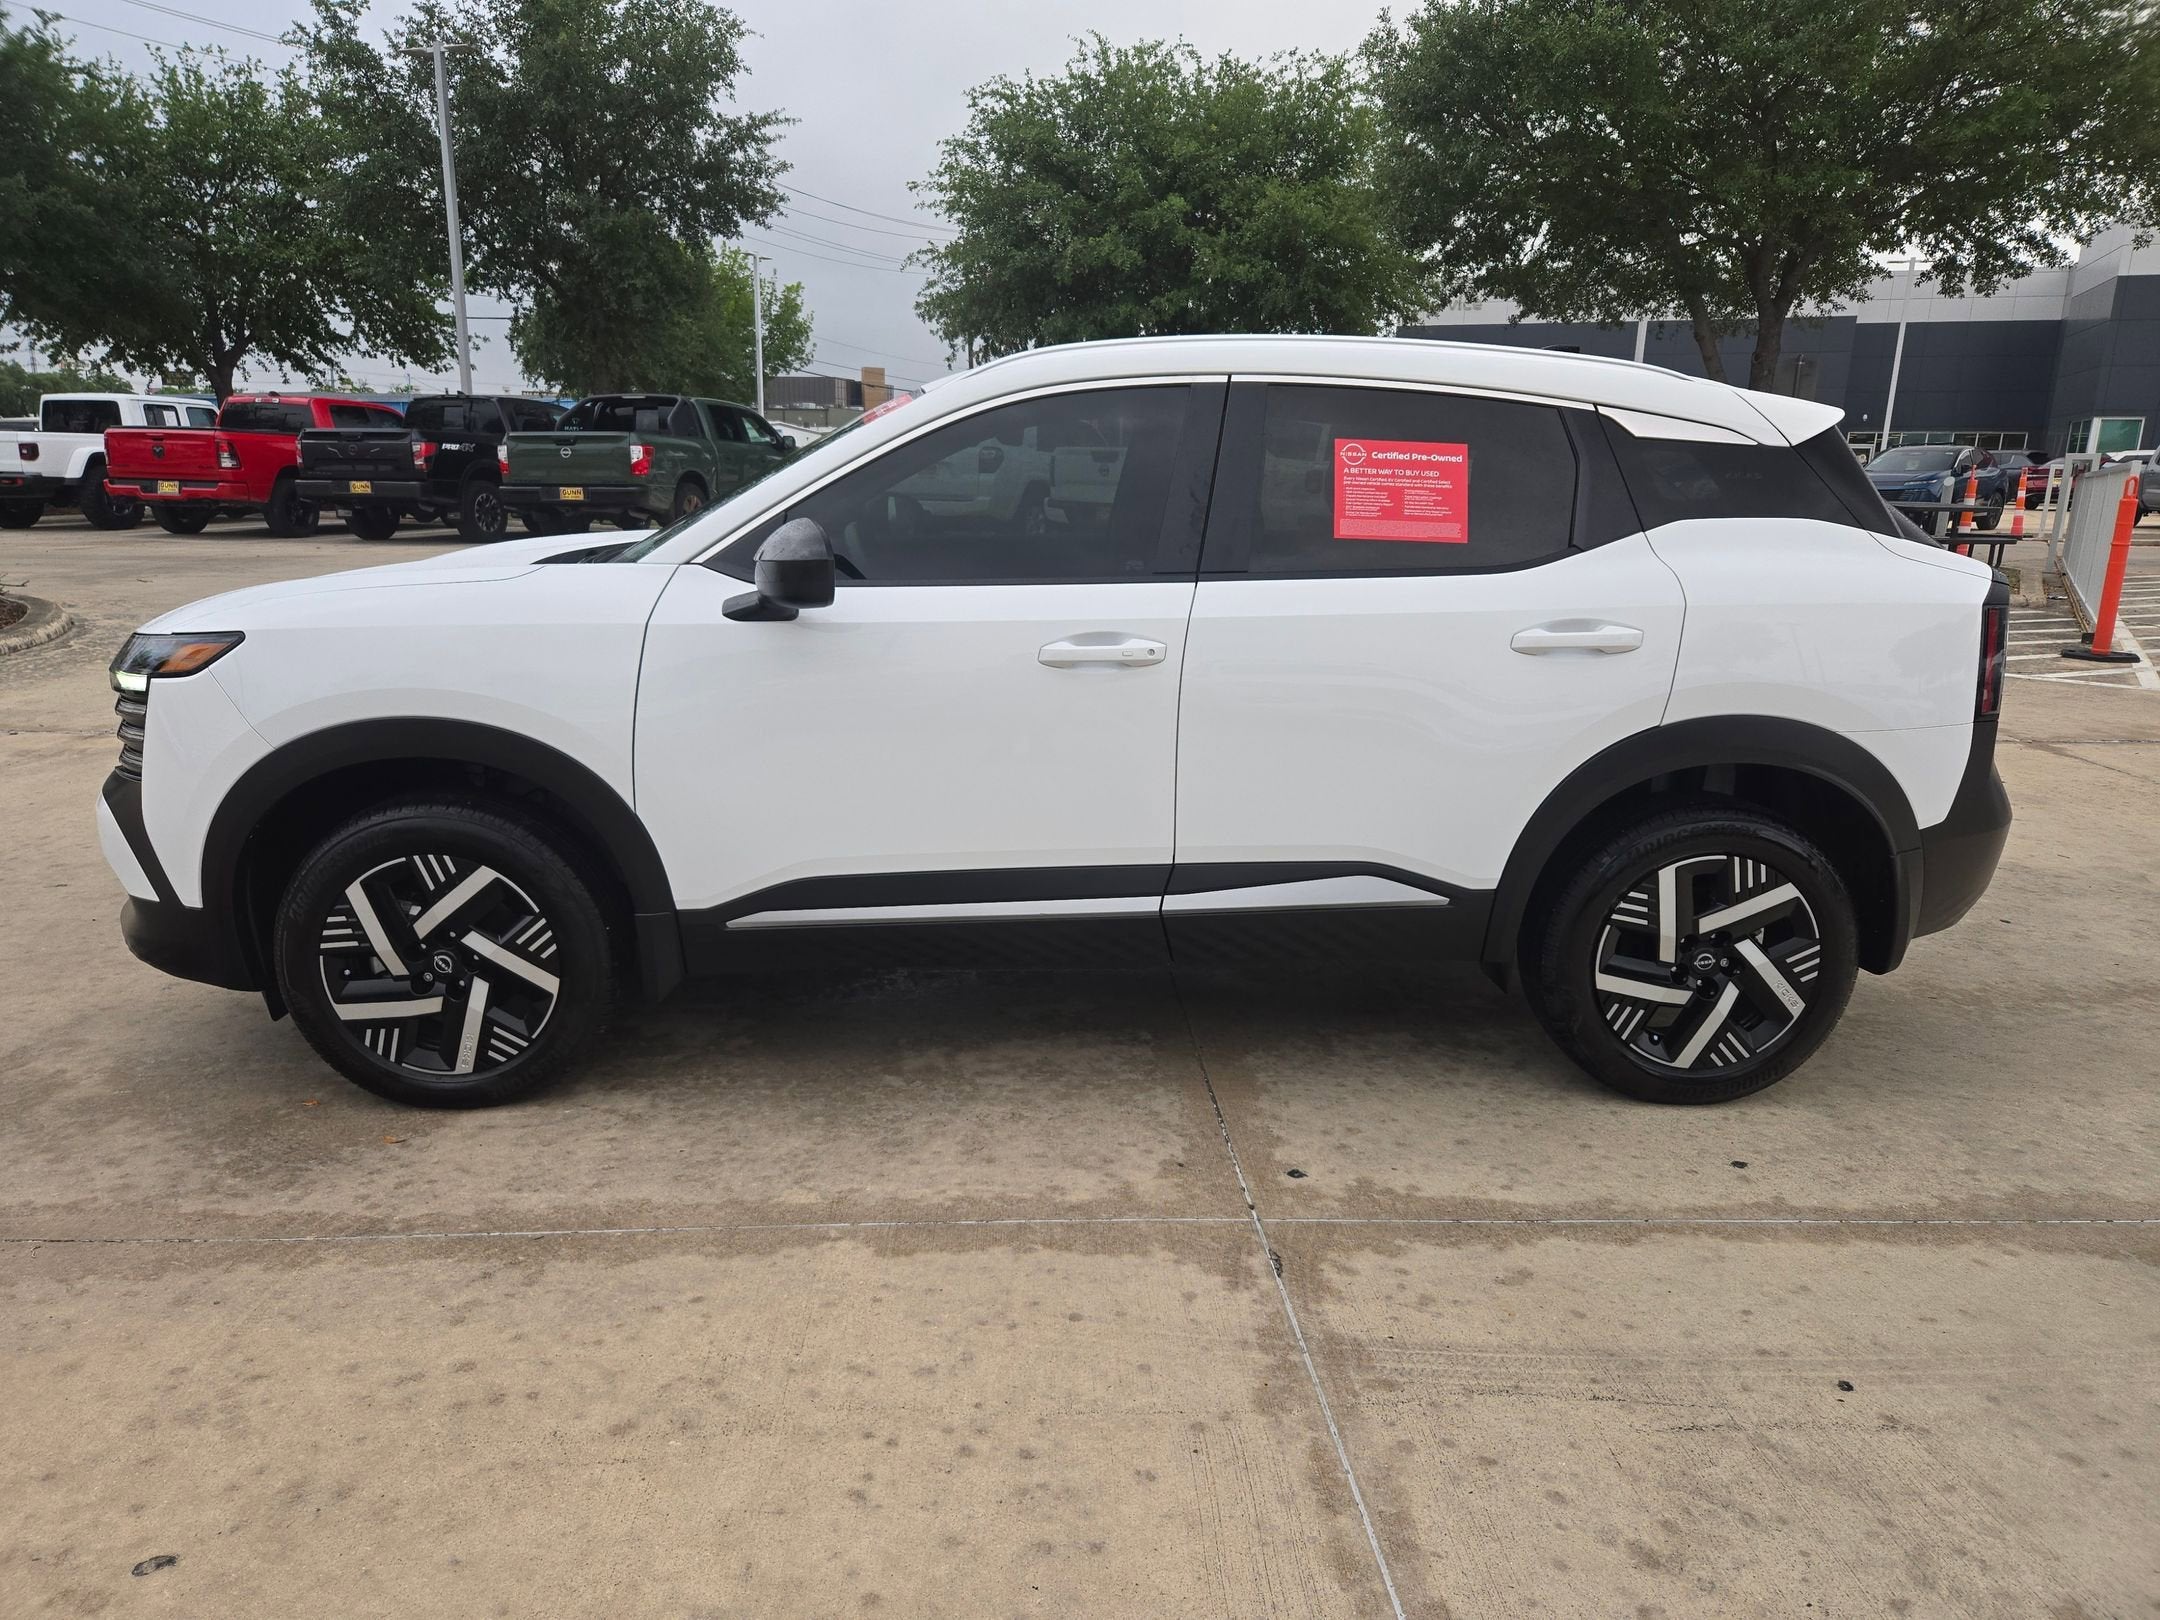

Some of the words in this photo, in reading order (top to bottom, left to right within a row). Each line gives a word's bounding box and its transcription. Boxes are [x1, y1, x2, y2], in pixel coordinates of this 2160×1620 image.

[1371, 451, 1410, 460] Certified
[1411, 453, 1463, 463] Pre-Owned
[1773, 979, 1800, 1009] KICKS
[461, 1032, 475, 1068] KICKS
